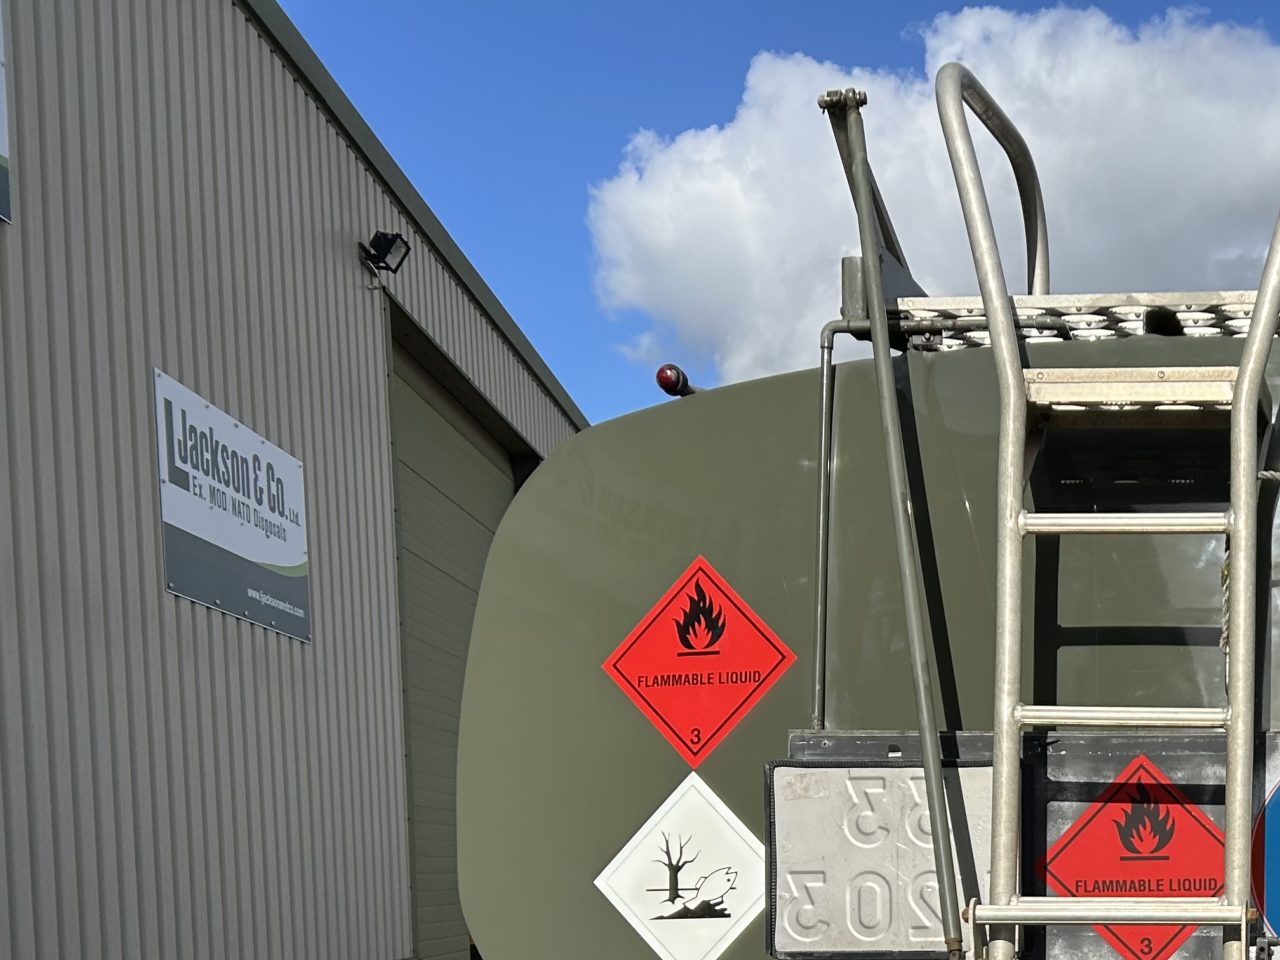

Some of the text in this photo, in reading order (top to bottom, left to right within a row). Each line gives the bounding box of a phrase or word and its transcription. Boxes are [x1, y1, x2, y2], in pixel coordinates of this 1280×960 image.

[192, 475, 207, 501] Ex.
[252, 453, 264, 506] &
[266, 462, 288, 520] Co.
[637, 670, 762, 689] FLAMMABLE LIQUID
[689, 728, 702, 745] 3
[1075, 877, 1218, 894] FLAMMABLE LIQUID
[1139, 937, 1153, 956] 3
